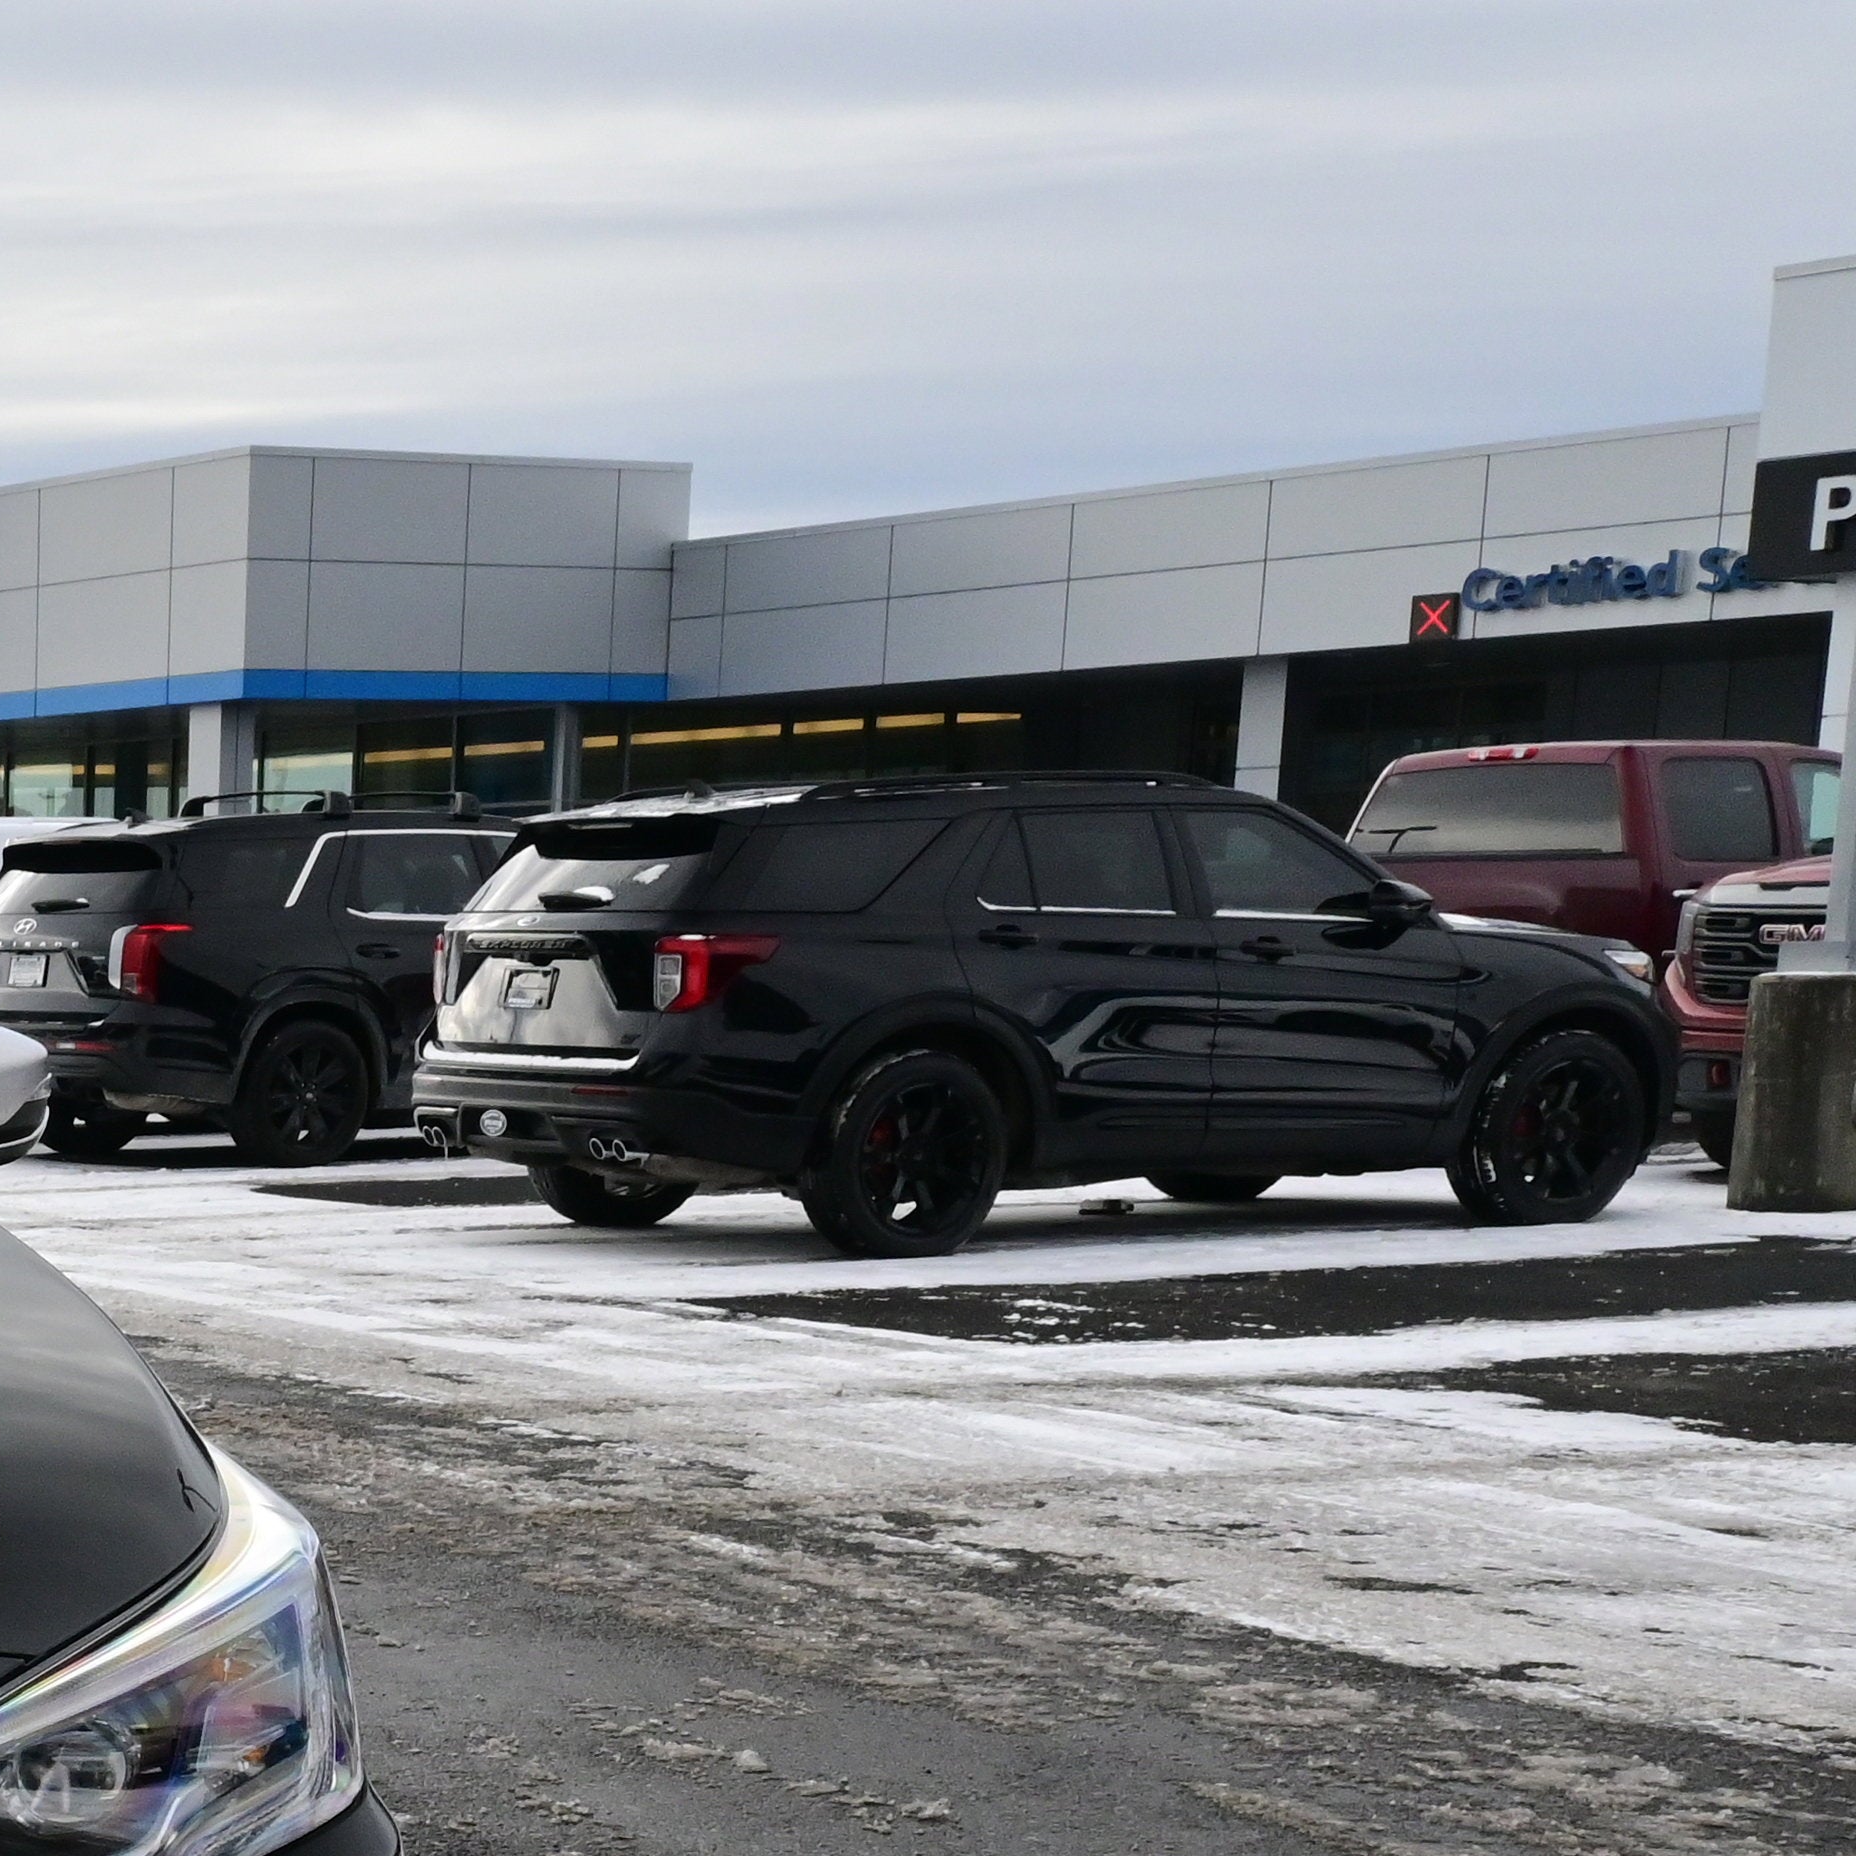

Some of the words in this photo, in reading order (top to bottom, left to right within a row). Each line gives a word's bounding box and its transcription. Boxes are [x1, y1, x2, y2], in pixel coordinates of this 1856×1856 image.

[1810, 474, 1856, 551] P
[1462, 548, 1682, 612] Certified
[1696, 547, 1766, 593] Se
[1759, 924, 1826, 944] GM
